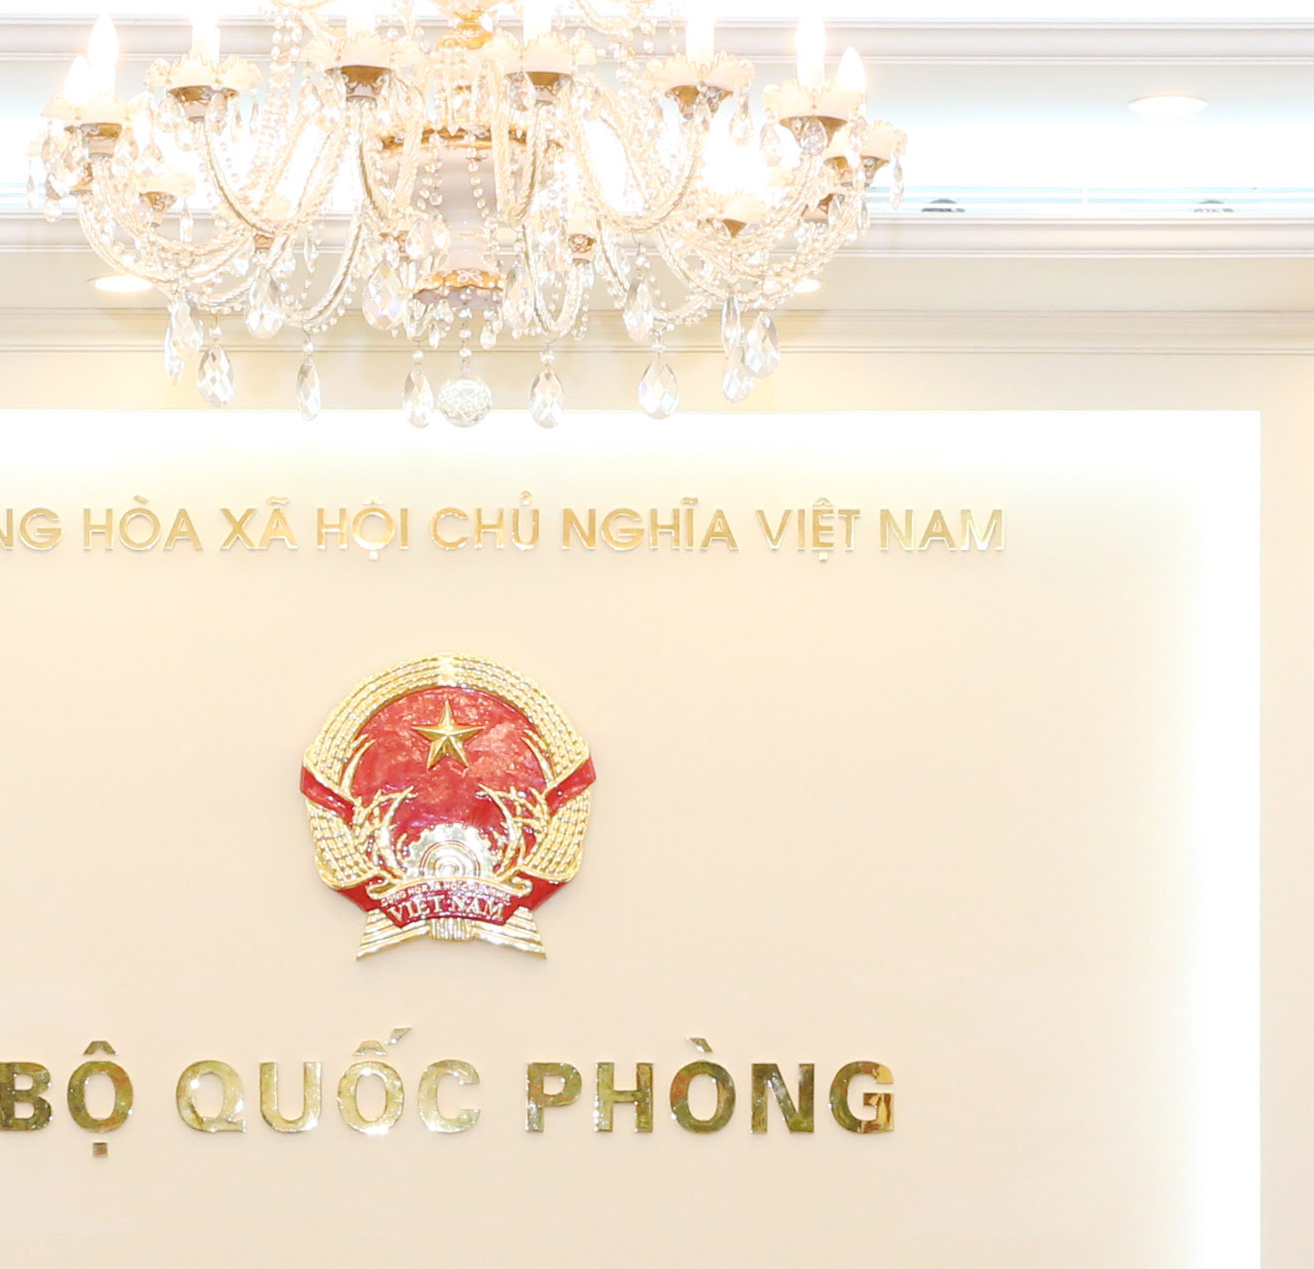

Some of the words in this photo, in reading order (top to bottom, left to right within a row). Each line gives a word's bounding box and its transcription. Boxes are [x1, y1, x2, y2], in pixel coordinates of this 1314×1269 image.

[83, 495, 203, 551] HÒA
[220, 497, 297, 551] XÃ
[316, 494, 409, 561] HỘI
[429, 490, 540, 551] CHỦ
[561, 496, 739, 551] NGHĨA
[755, 497, 861, 561] VIỆT
[880, 508, 1005, 551] NAM
[450, 895, 504, 920] NAM
[176, 1027, 481, 1134] QUỐC
[524, 1037, 895, 1134] PHÒNG
